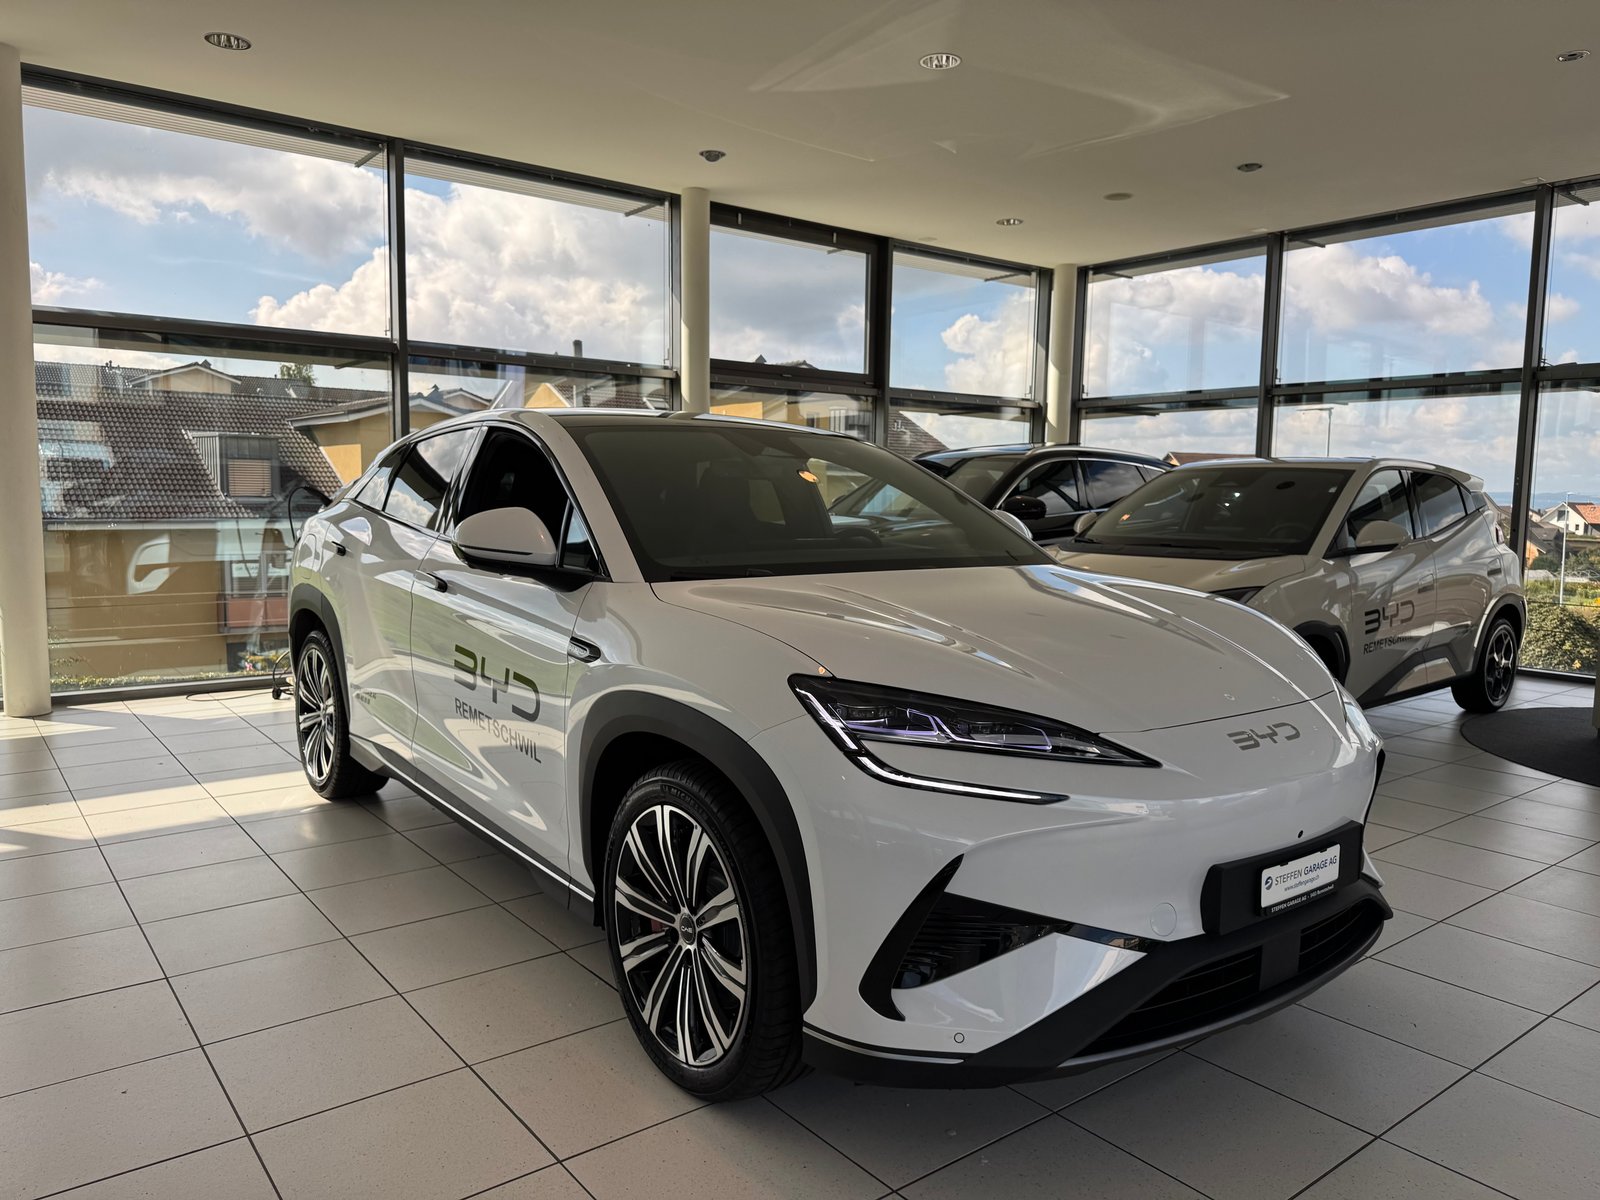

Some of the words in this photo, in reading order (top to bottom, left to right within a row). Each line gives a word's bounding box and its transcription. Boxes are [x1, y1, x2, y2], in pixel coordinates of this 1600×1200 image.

[1364, 600, 1415, 635] BYD
[1363, 633, 1413, 655] REMETSCH
[454, 644, 541, 722] BYD
[455, 697, 541, 763] REMETSCHWIL
[1227, 722, 1300, 751] BYD
[1275, 868, 1303, 886] STEFFEN
[1303, 859, 1328, 875] GARAGE
[1328, 855, 1337, 866] AG
[1271, 903, 1287, 912] STEFFEN
[1287, 897, 1301, 907] GARAGE
